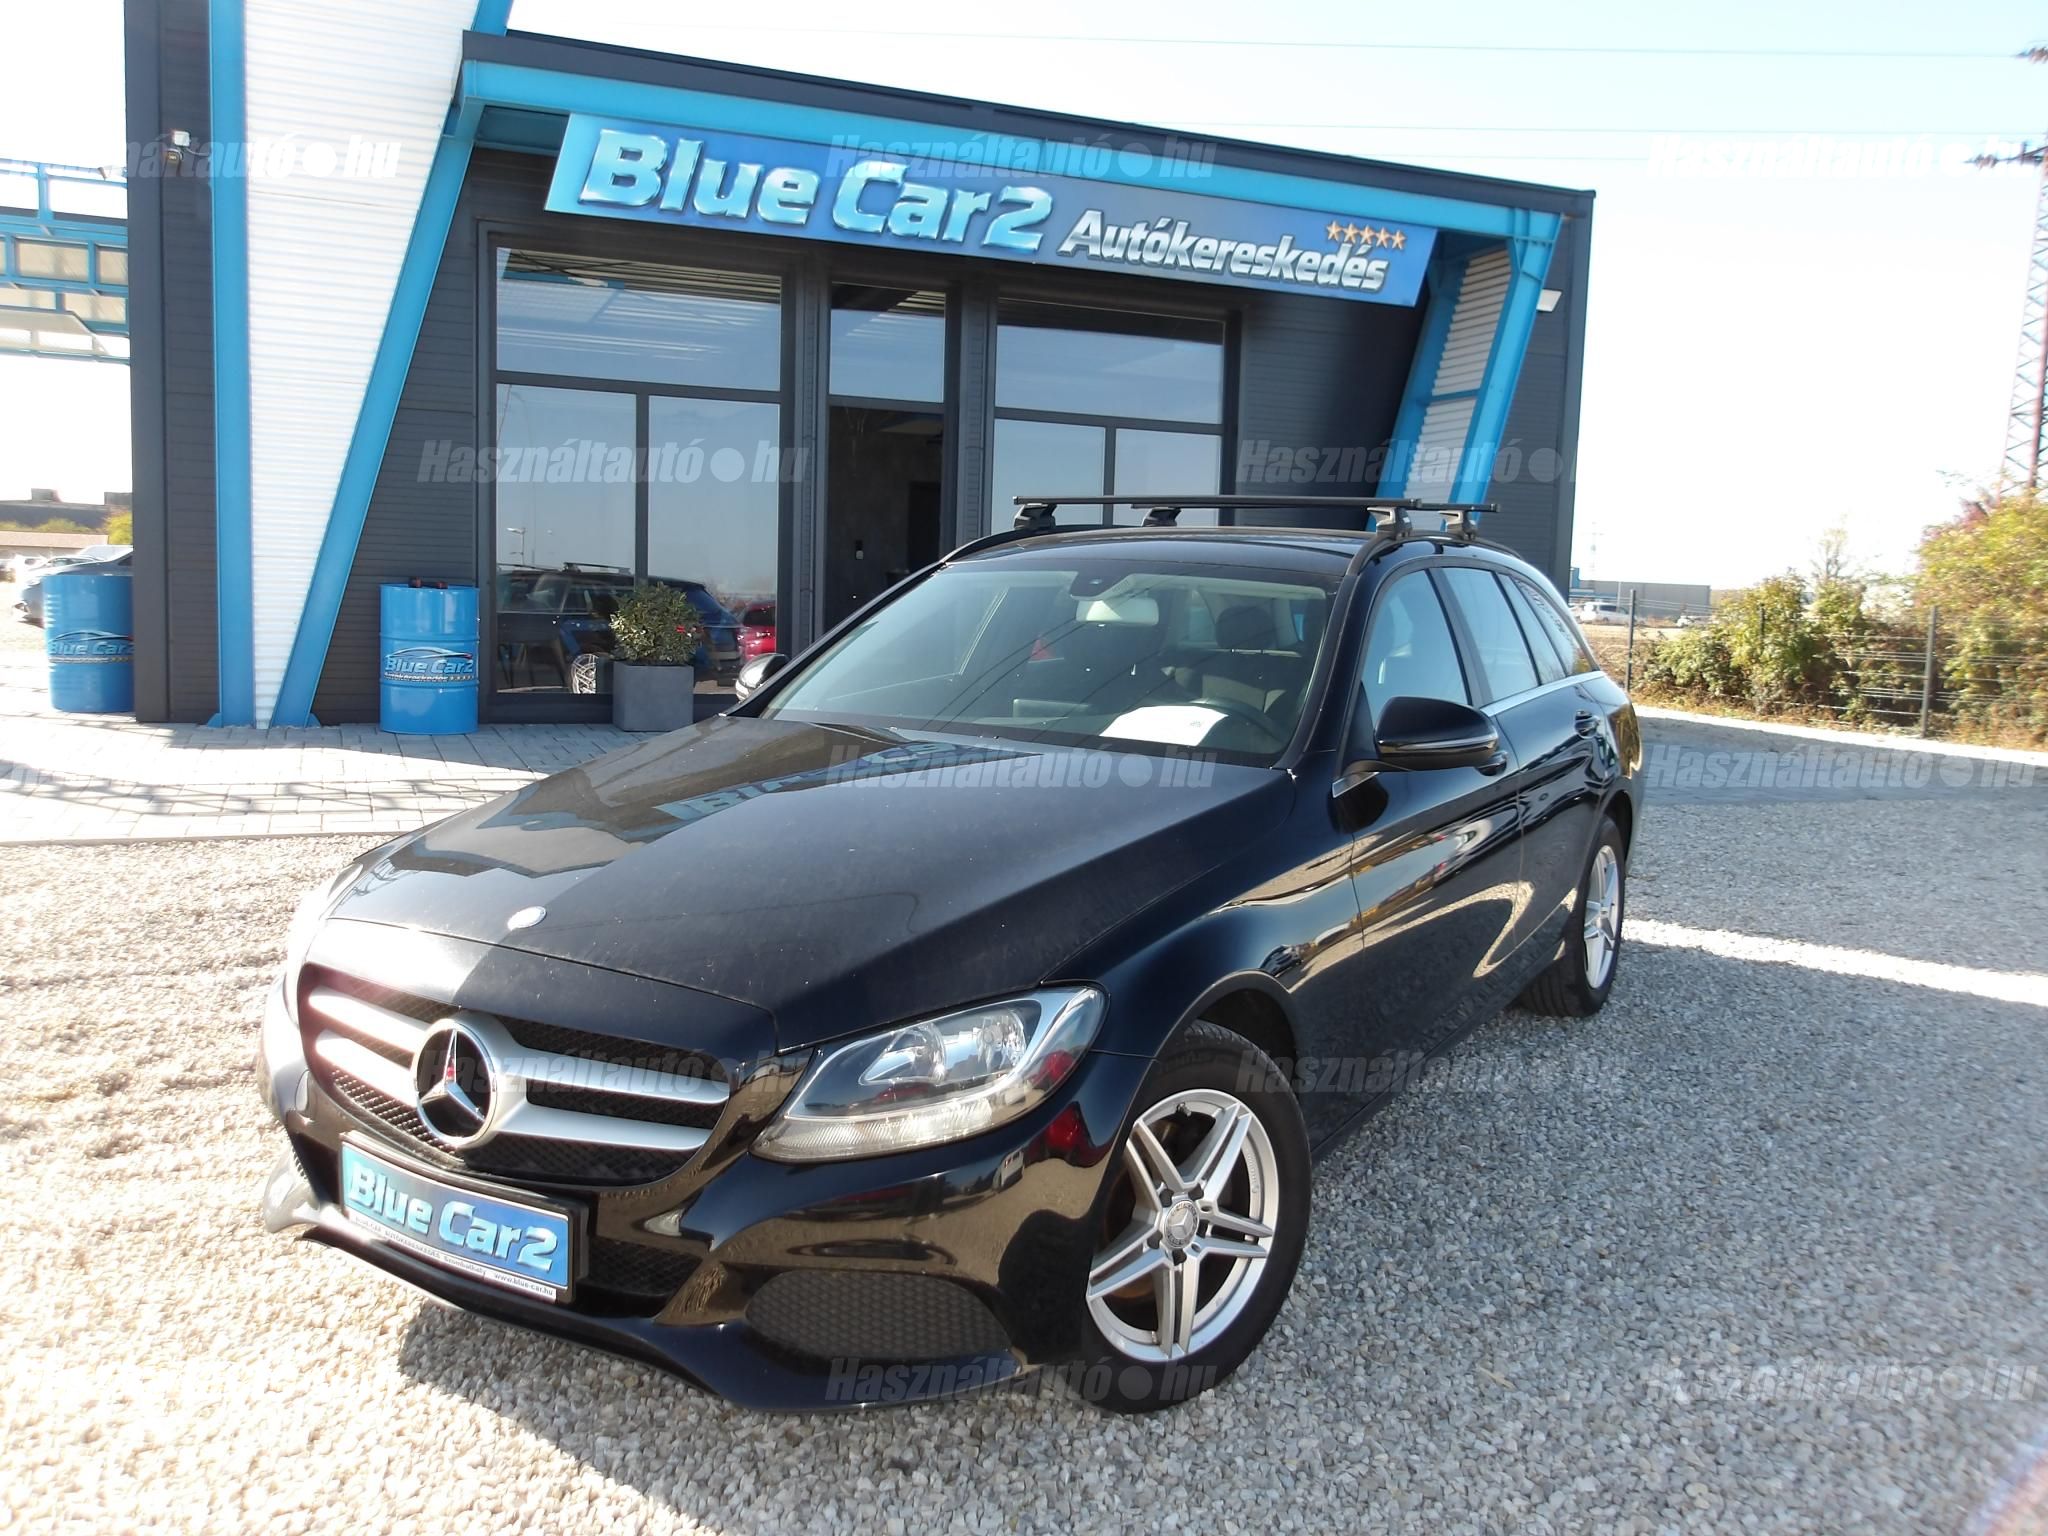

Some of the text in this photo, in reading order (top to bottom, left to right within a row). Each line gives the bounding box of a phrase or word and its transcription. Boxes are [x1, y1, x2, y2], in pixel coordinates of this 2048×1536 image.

[578, 129, 1391, 293] Blue Car2 Autókereskedés
[48, 641, 88, 655] Blue
[385, 655, 474, 674] Blue Car2
[350, 1163, 558, 1274] Blue Car2
[495, 1272, 554, 1296] www.blue-car.hu
